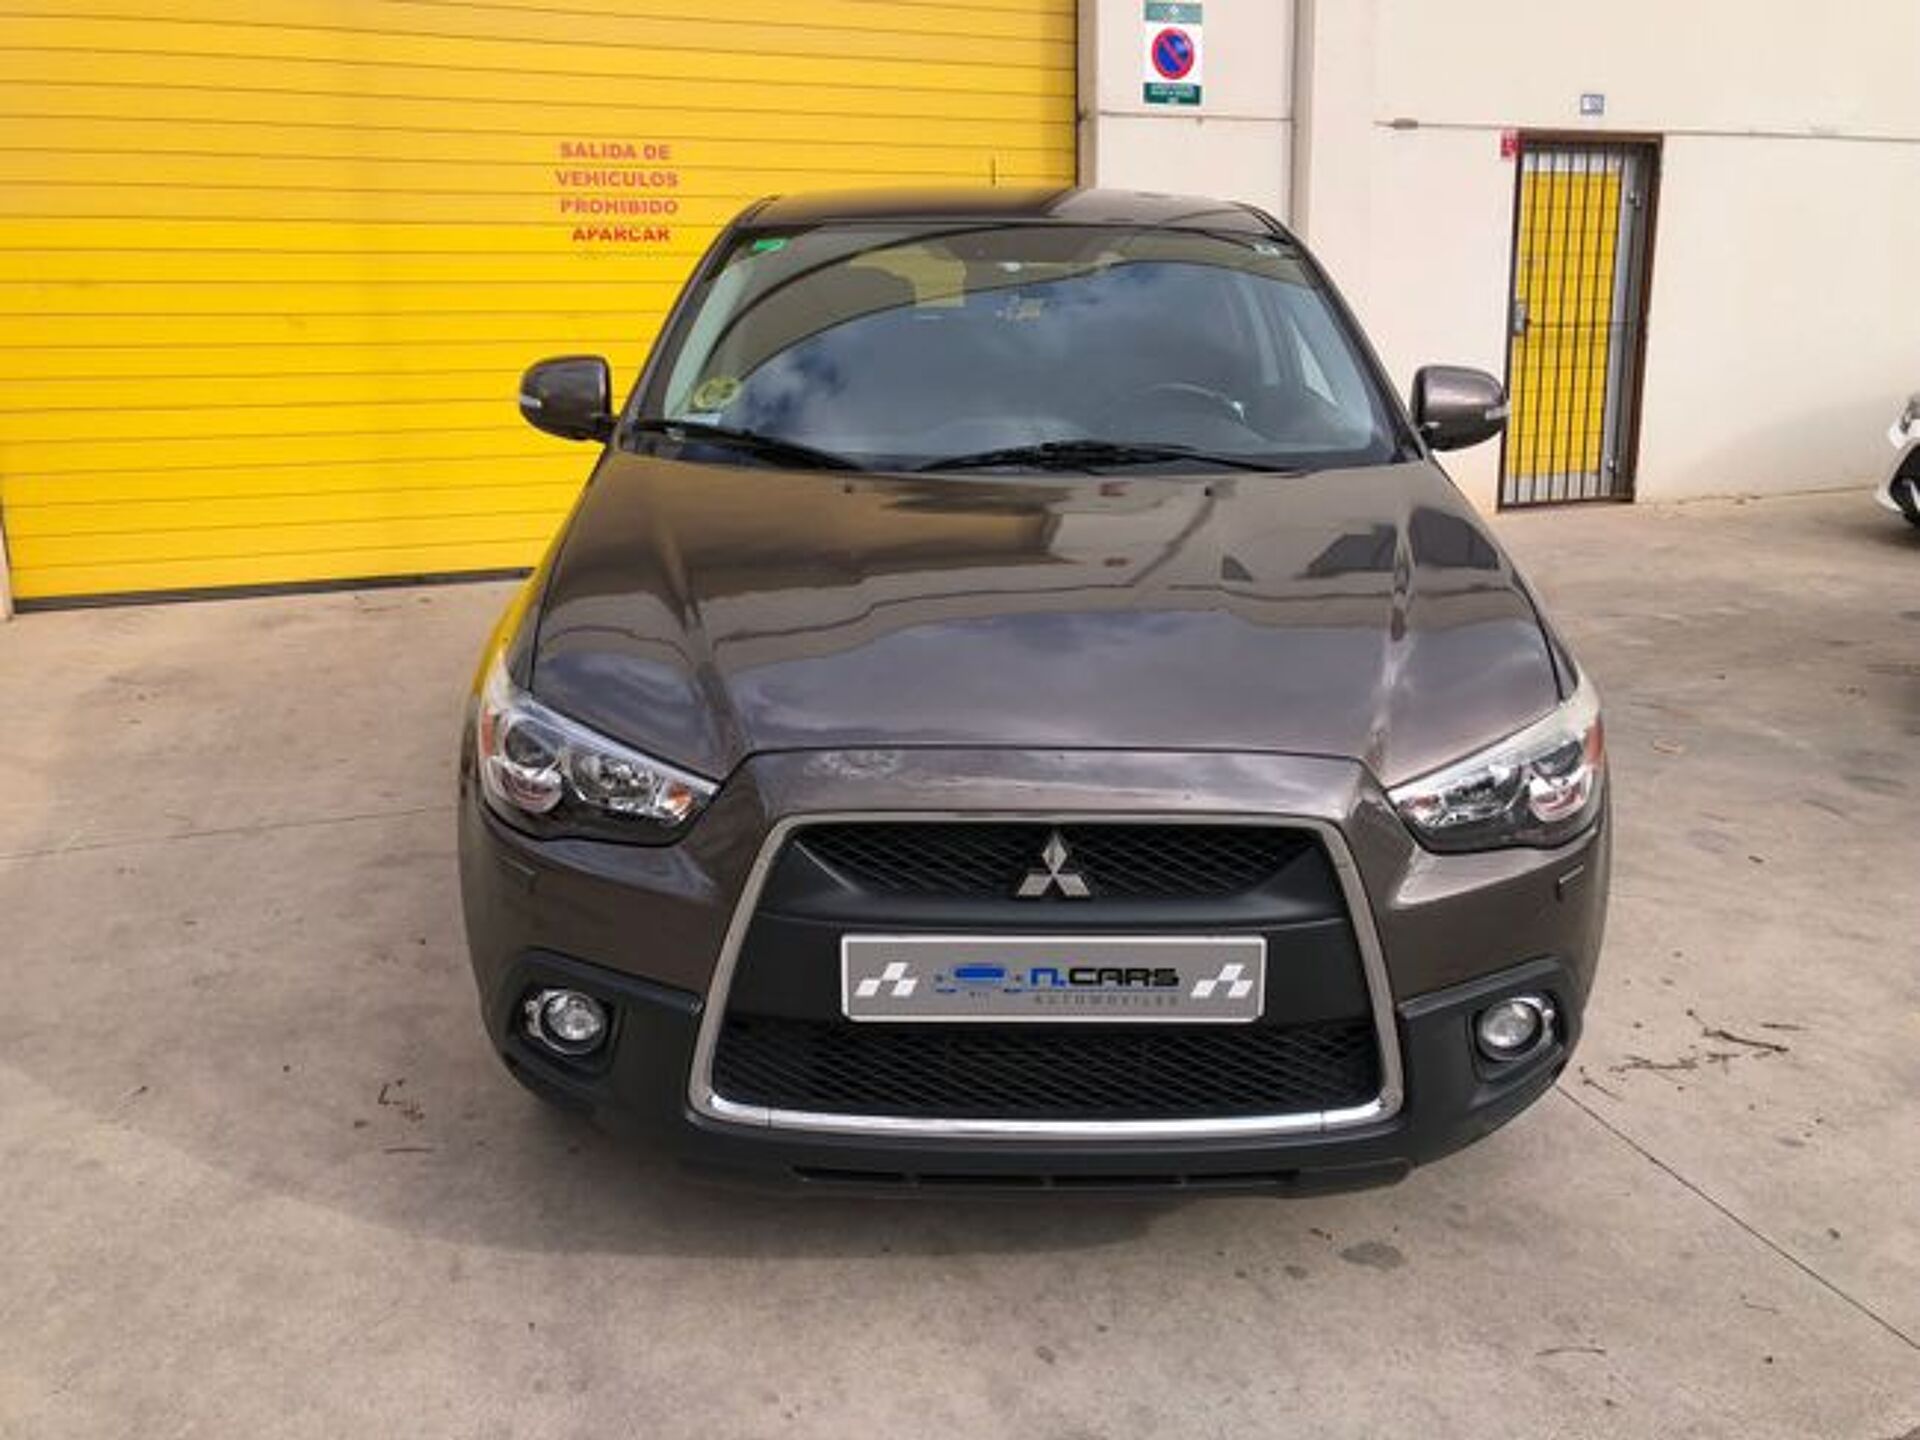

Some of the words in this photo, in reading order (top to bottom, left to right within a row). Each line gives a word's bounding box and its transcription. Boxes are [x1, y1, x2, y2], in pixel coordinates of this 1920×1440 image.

[560, 141, 637, 160] SALIDA
[643, 143, 672, 161] DE
[554, 169, 679, 188] VEHICULOS
[560, 198, 679, 214] PROHIBIDO
[572, 225, 671, 242] APARCAR
